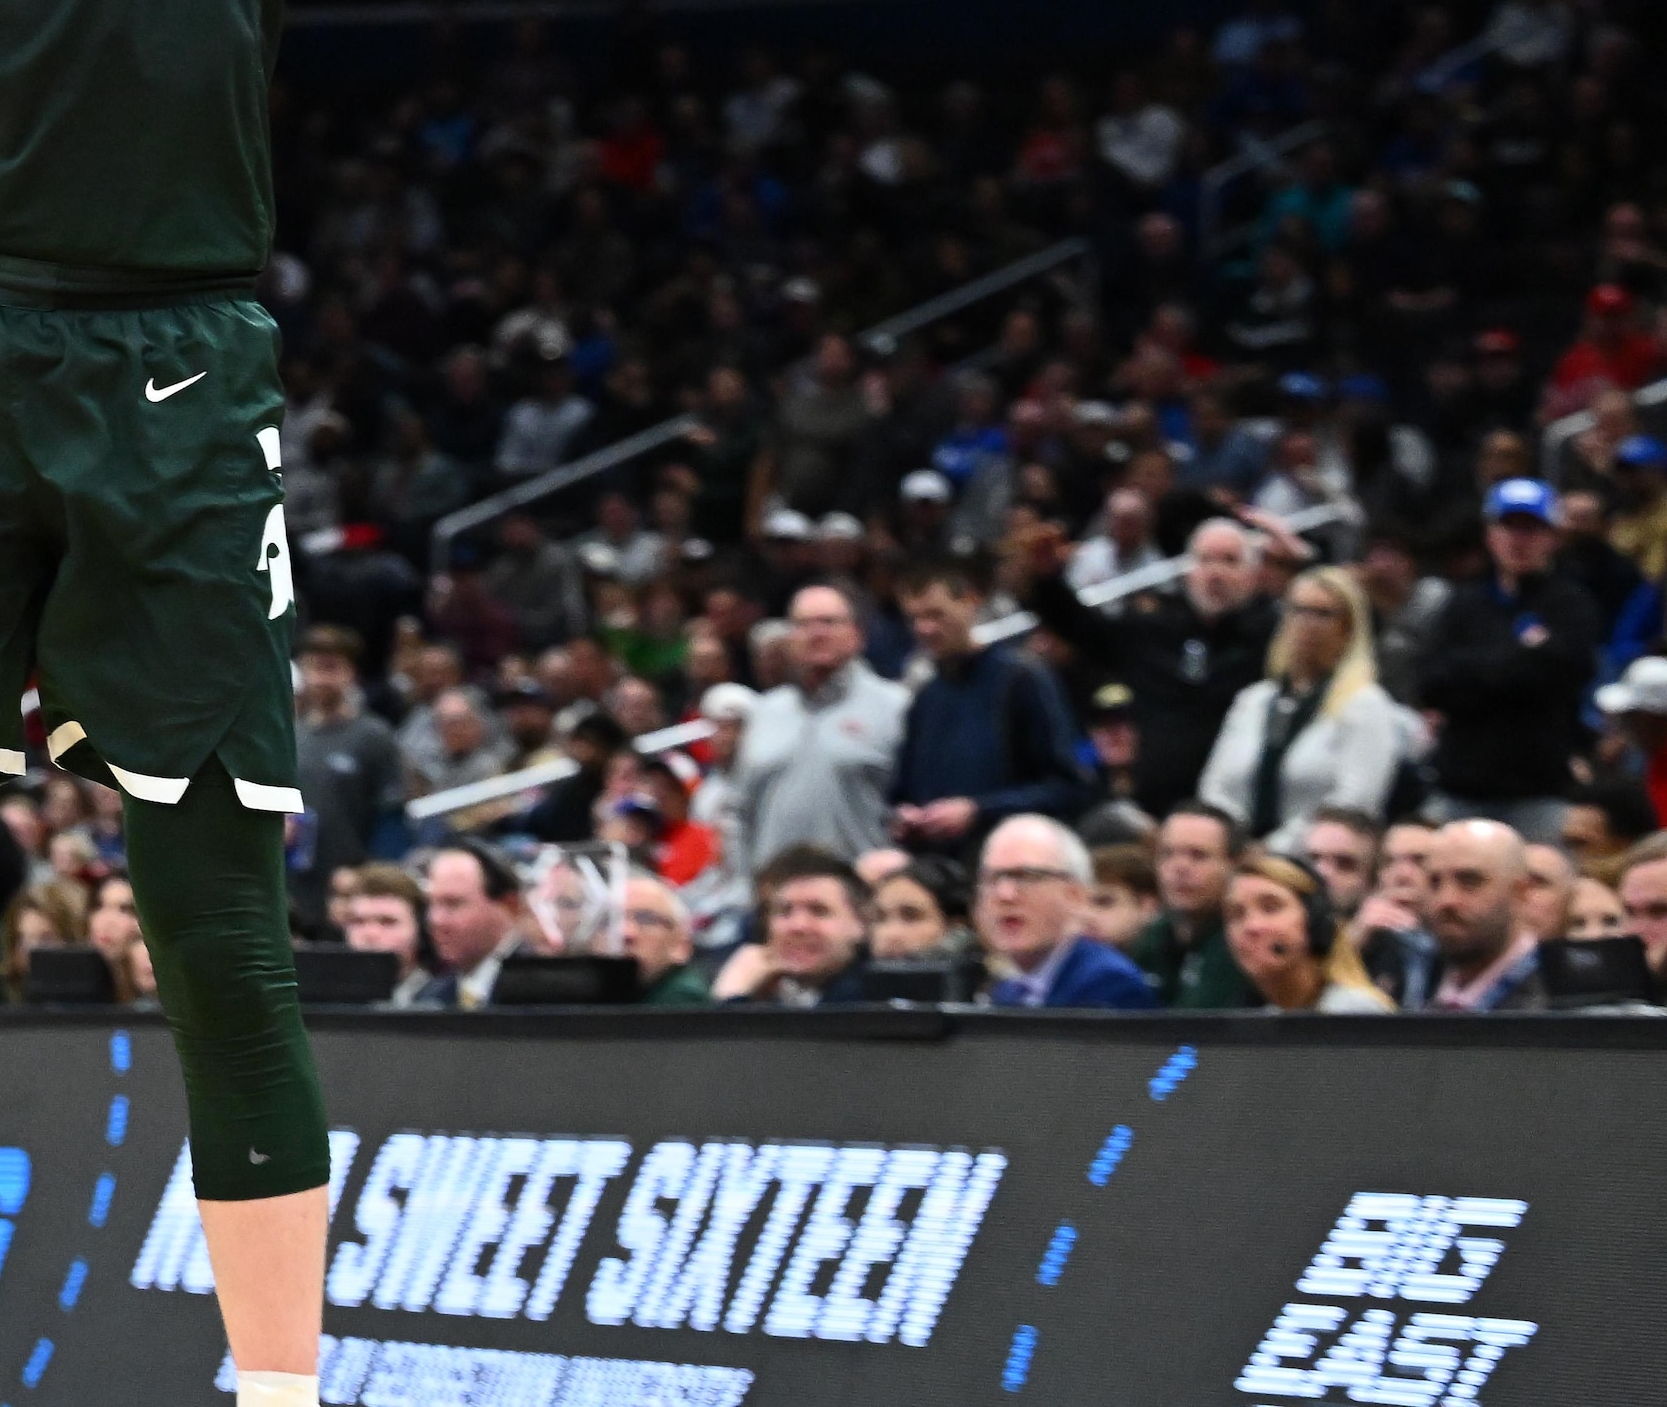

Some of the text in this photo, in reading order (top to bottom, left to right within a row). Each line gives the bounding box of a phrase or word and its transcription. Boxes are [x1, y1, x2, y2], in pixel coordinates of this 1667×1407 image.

[325, 1126, 634, 1322] SWEET
[585, 1135, 1009, 1348] SIXTEEN
[1295, 1191, 1530, 1305] BIG
[1233, 1302, 1540, 1407] EAST
